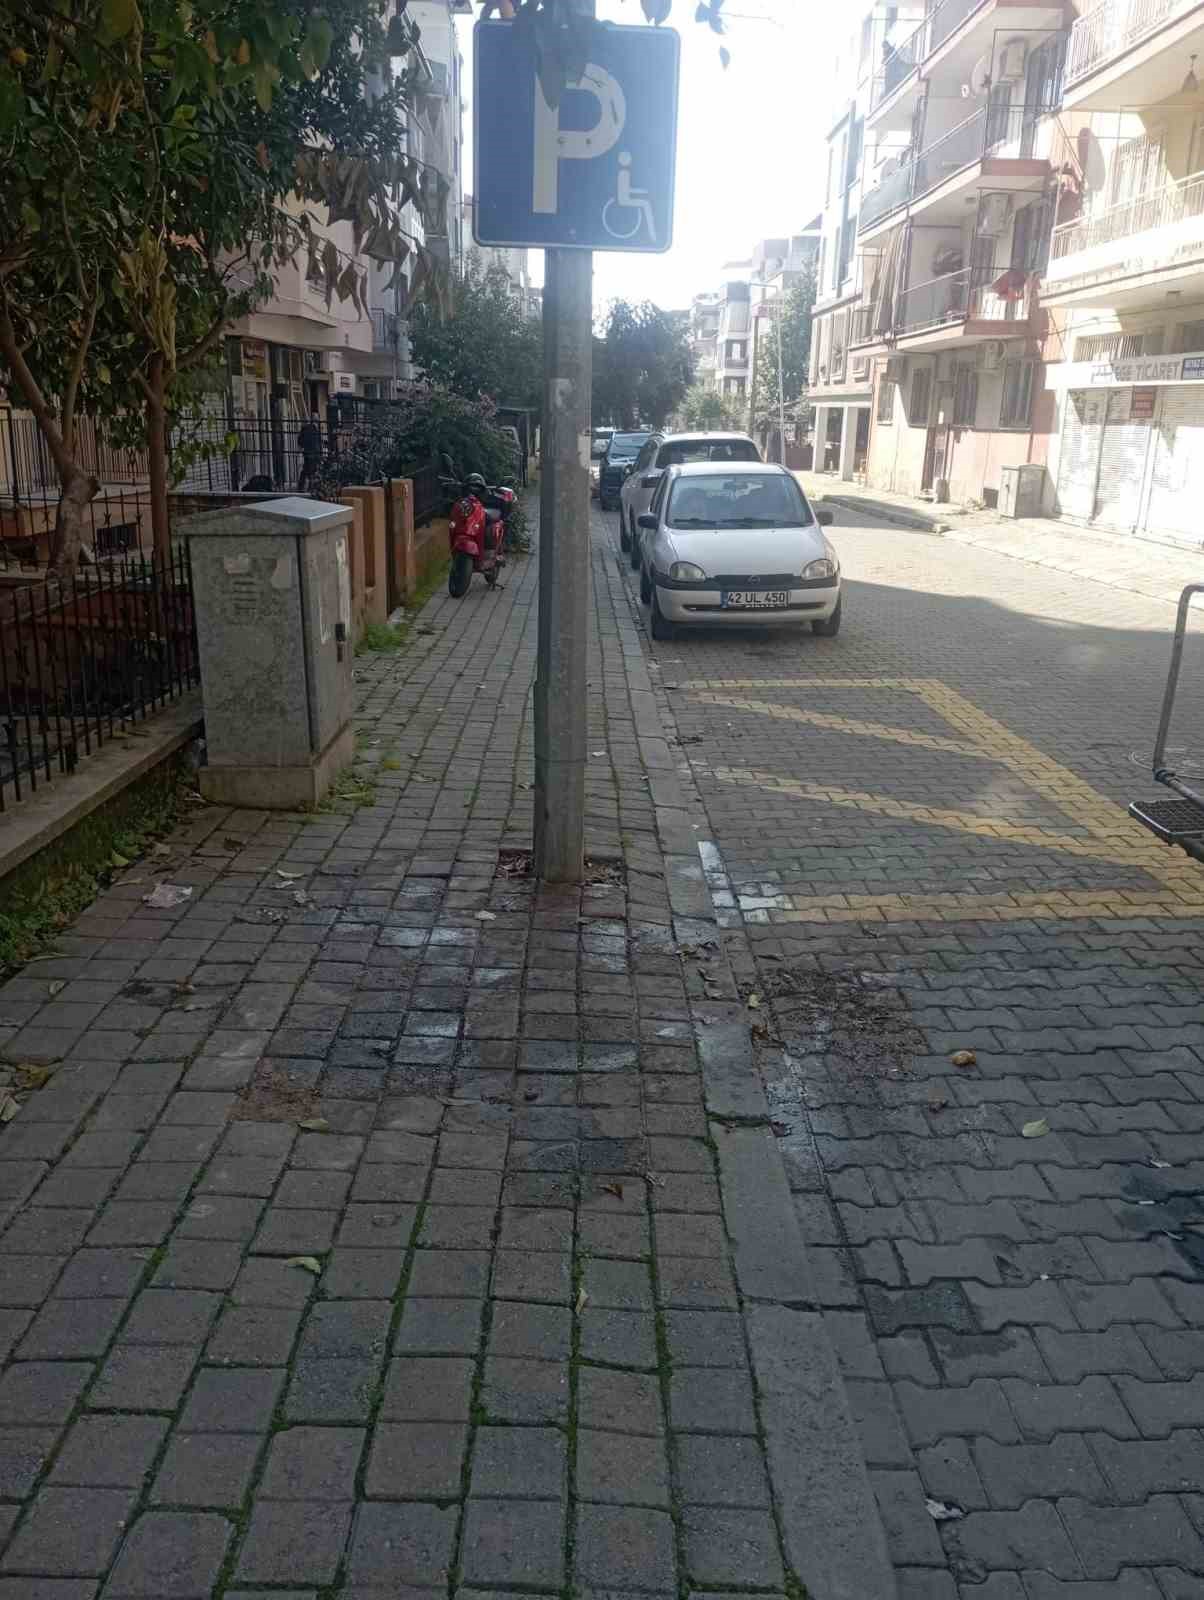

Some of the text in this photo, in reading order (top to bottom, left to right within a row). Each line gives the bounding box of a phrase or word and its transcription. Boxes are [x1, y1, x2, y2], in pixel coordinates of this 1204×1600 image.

[532, 52, 626, 214] P
[727, 592, 785, 604] 42 UL 450
